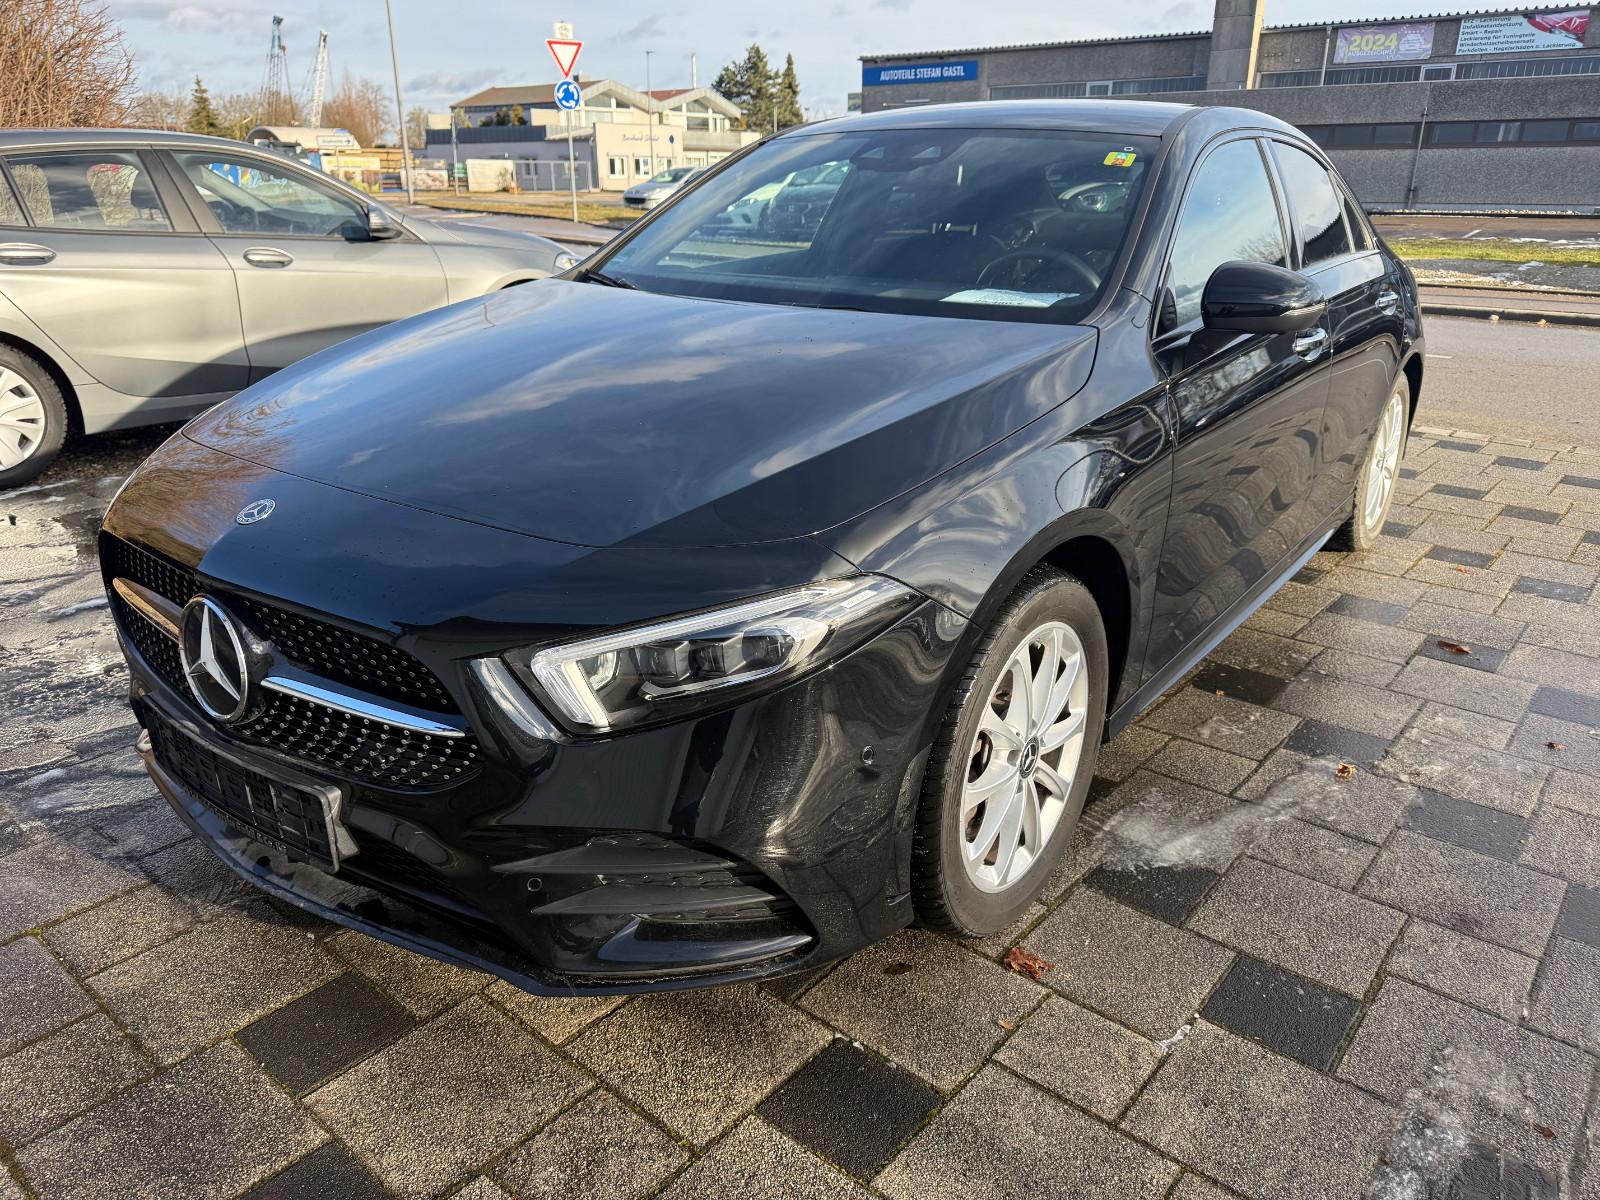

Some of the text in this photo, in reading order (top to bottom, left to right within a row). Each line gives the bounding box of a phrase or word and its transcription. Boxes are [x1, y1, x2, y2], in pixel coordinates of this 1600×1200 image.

[1349, 33, 1398, 52] 2024
[880, 65, 966, 81] AUTOTEILE STEFAN GASTL
